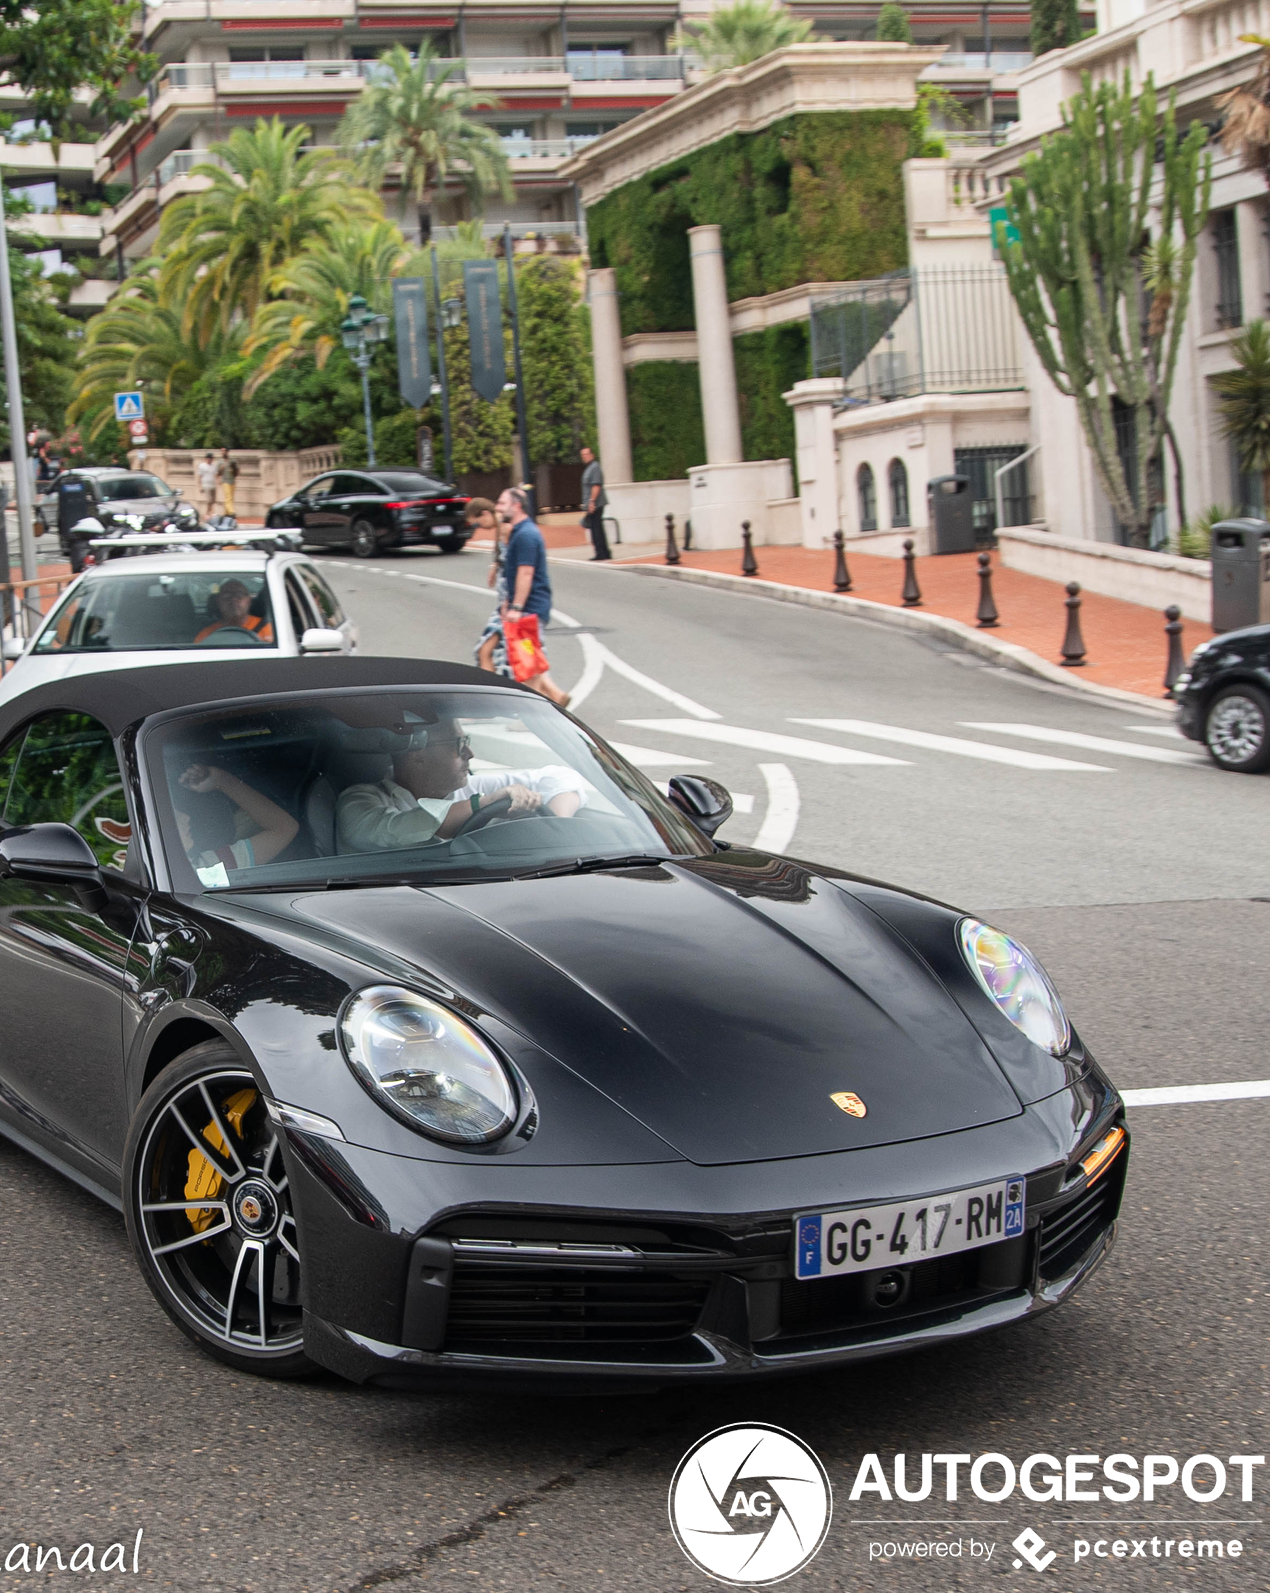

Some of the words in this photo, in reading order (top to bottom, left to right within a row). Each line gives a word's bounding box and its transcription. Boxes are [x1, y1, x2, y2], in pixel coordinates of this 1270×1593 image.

[194, 1156, 208, 1193] PORSC
[826, 1191, 1003, 1266] GG-417-RM
[1006, 1210, 1022, 1228] 2A
[805, 1251, 813, 1265] F
